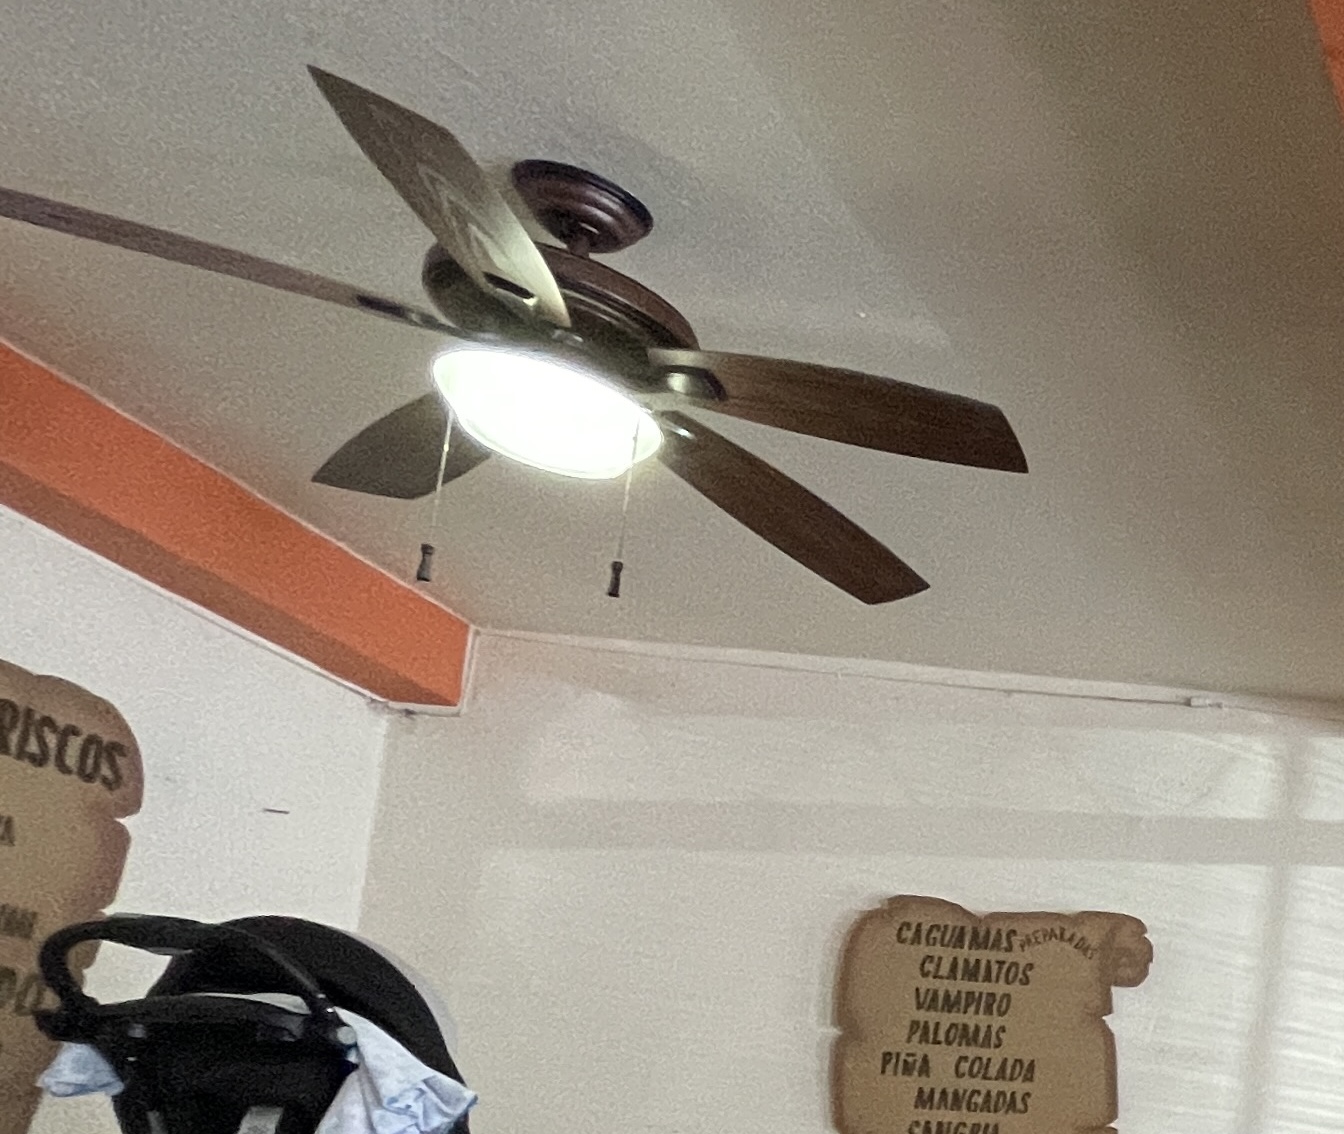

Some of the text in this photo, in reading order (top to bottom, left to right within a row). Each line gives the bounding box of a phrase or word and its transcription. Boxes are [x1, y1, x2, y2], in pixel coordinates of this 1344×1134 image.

[896, 920, 1018, 952] CAGUAMAS
[919, 955, 1034, 986] CLAMATOS
[915, 987, 1012, 1017] VAMPIRO
[906, 1019, 1006, 1049] PALOMAS
[880, 1051, 1036, 1082] PIÑA COLADA
[913, 1086, 1032, 1114] MANGADAS
